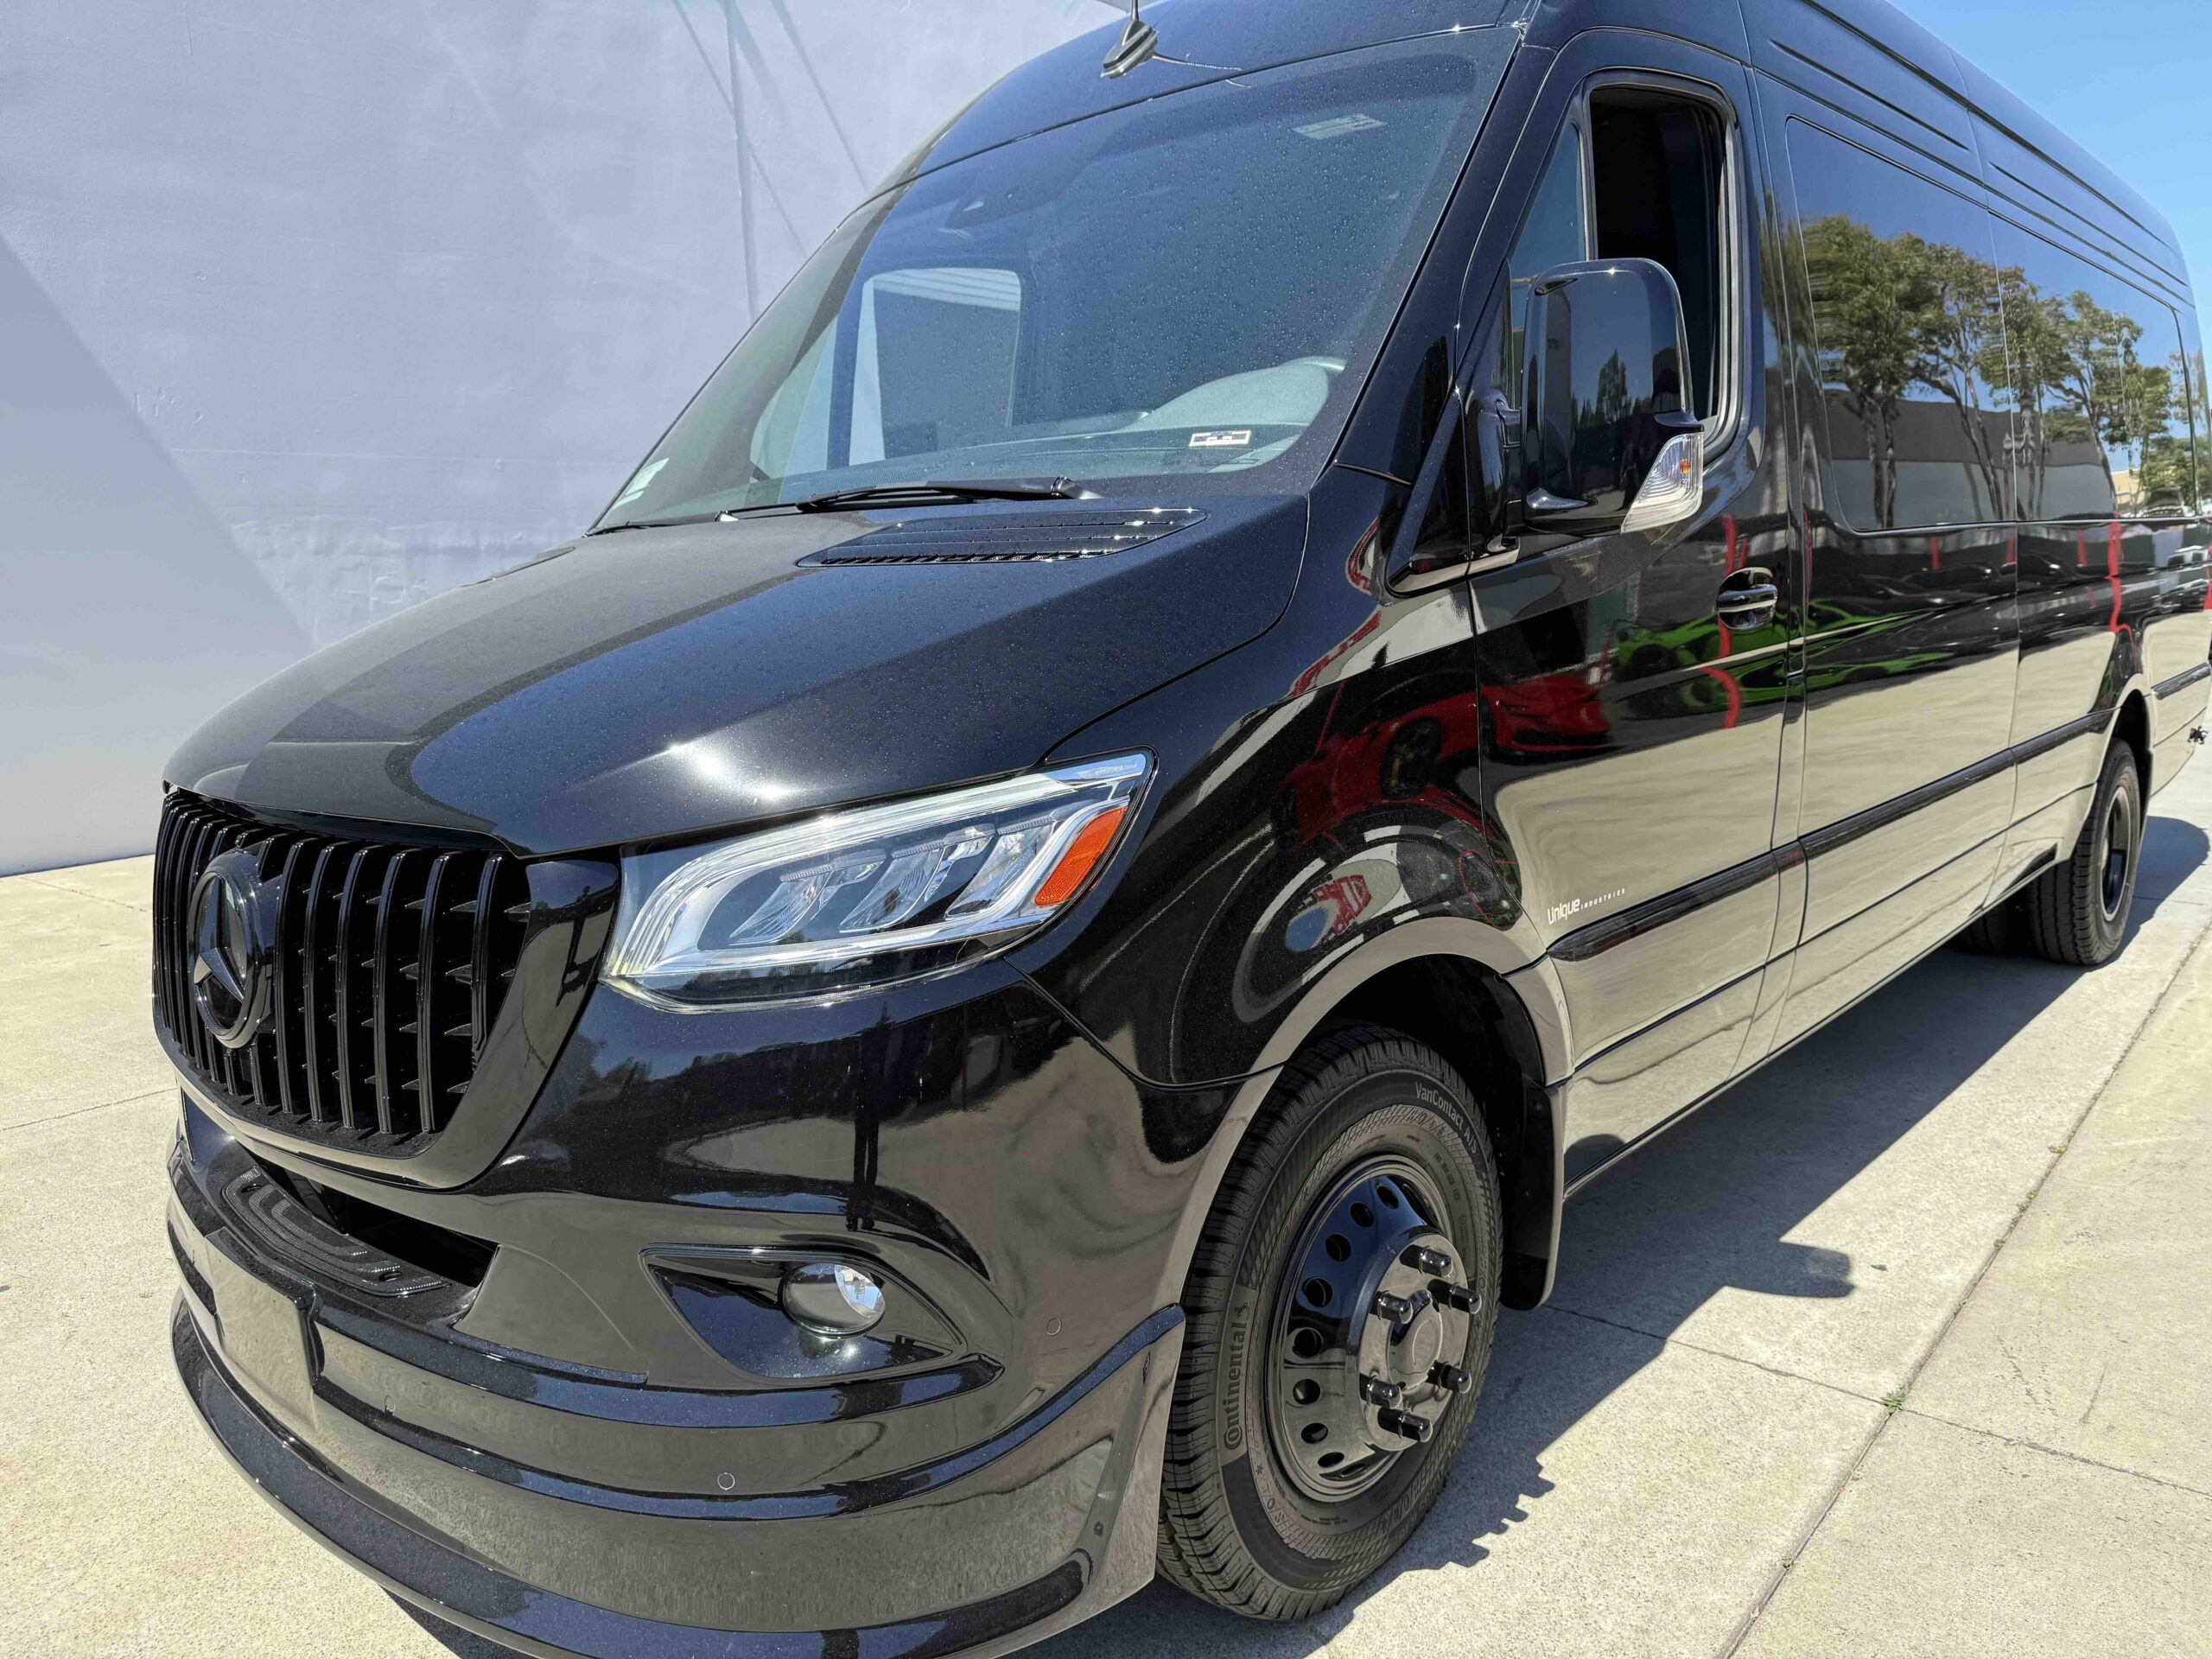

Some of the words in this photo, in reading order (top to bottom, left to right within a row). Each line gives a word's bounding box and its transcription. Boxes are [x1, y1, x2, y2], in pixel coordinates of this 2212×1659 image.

[1548, 898, 1580, 925] Unique
[1414, 1081, 1464, 1130] VanContact
[1464, 1126, 1478, 1154] A/S
[1223, 1321, 1248, 1451] Continental
